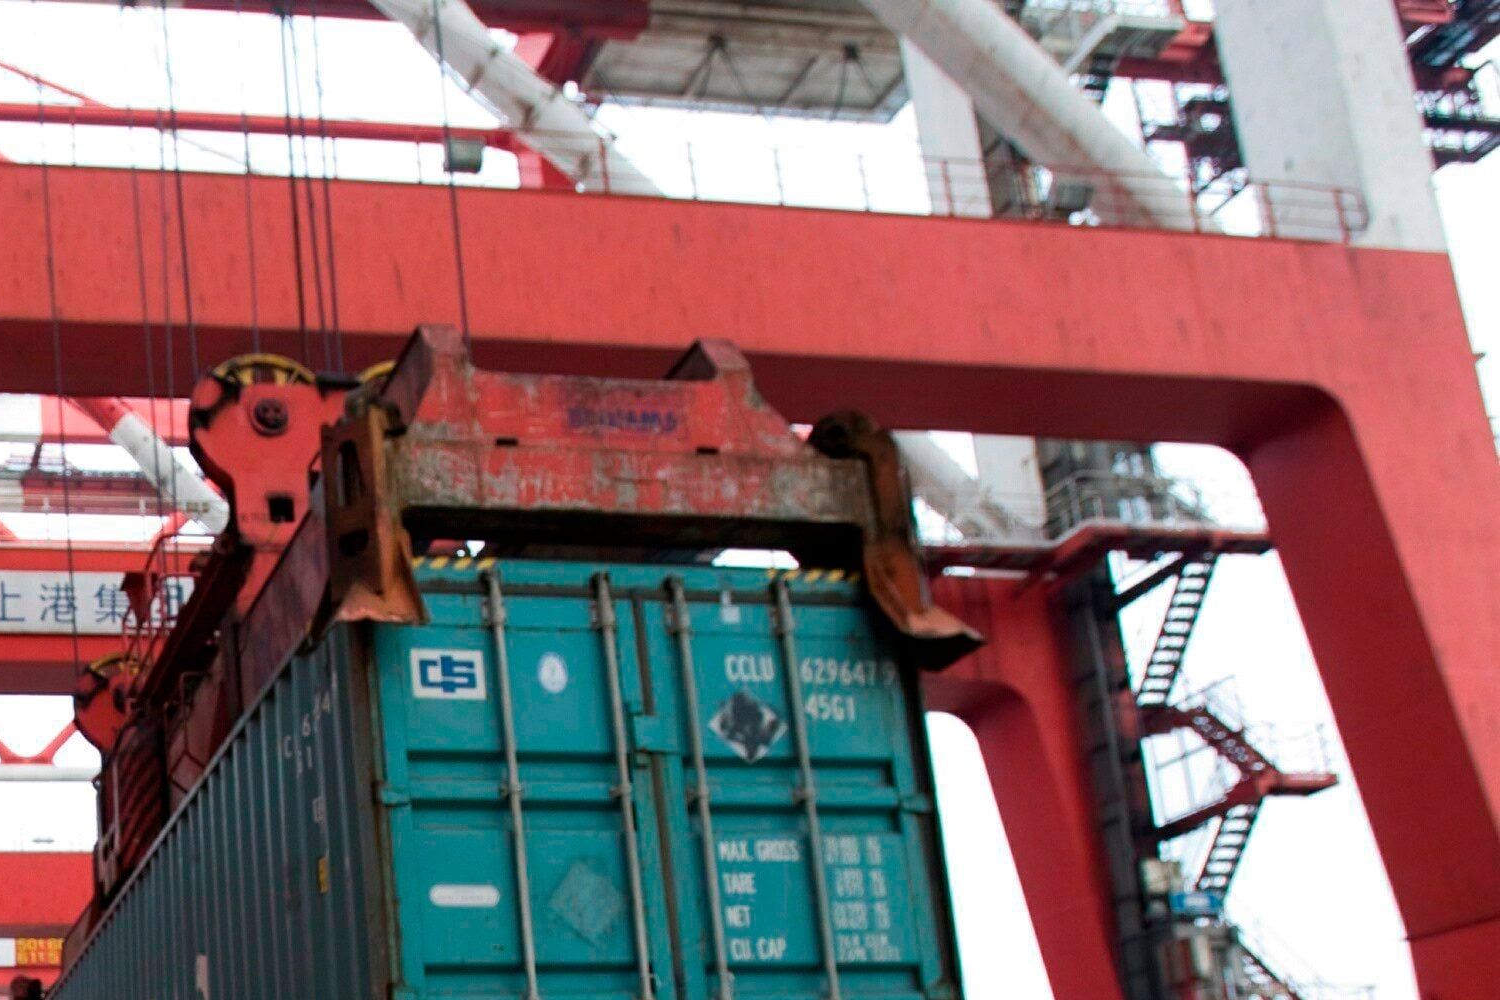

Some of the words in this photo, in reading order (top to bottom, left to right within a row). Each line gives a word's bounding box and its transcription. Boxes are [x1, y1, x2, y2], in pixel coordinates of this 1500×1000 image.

[724, 654, 776, 682] CCLU
[805, 693, 857, 723] 45G1
[755, 839, 801, 863] GROSS
[722, 872, 757, 896] TARE
[725, 904, 751, 928] NET
[756, 936, 787, 961] CAP
